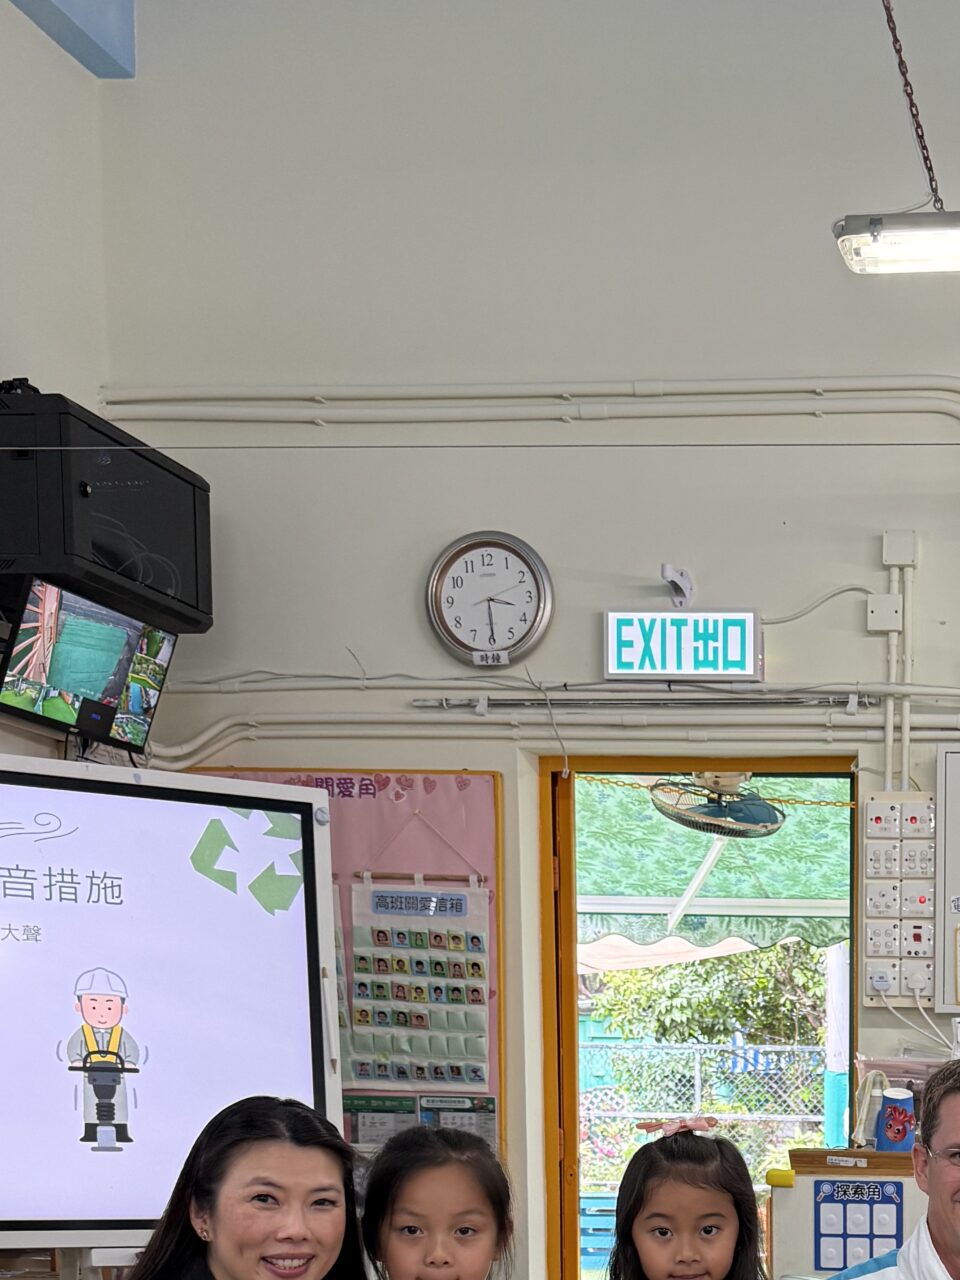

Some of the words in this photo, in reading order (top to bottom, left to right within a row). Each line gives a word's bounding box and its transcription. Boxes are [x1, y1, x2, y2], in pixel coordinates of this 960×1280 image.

[464, 560, 475, 573] 11
[481, 553, 494, 567] 12
[505, 557, 509, 570] 1
[452, 576, 464, 589] 10
[518, 571, 526, 583] 2
[446, 596, 454, 608] 9
[525, 590, 533, 603] 3
[454, 616, 462, 629] 8
[520, 612, 527, 624] 4
[470, 629, 477, 642] 7
[488, 633, 496, 646] 6
[507, 627, 515, 639] 5
[616, 618, 688, 670] EXIT
[693, 618, 747, 671] 出口
[835, 1183, 881, 1199] 探索角
